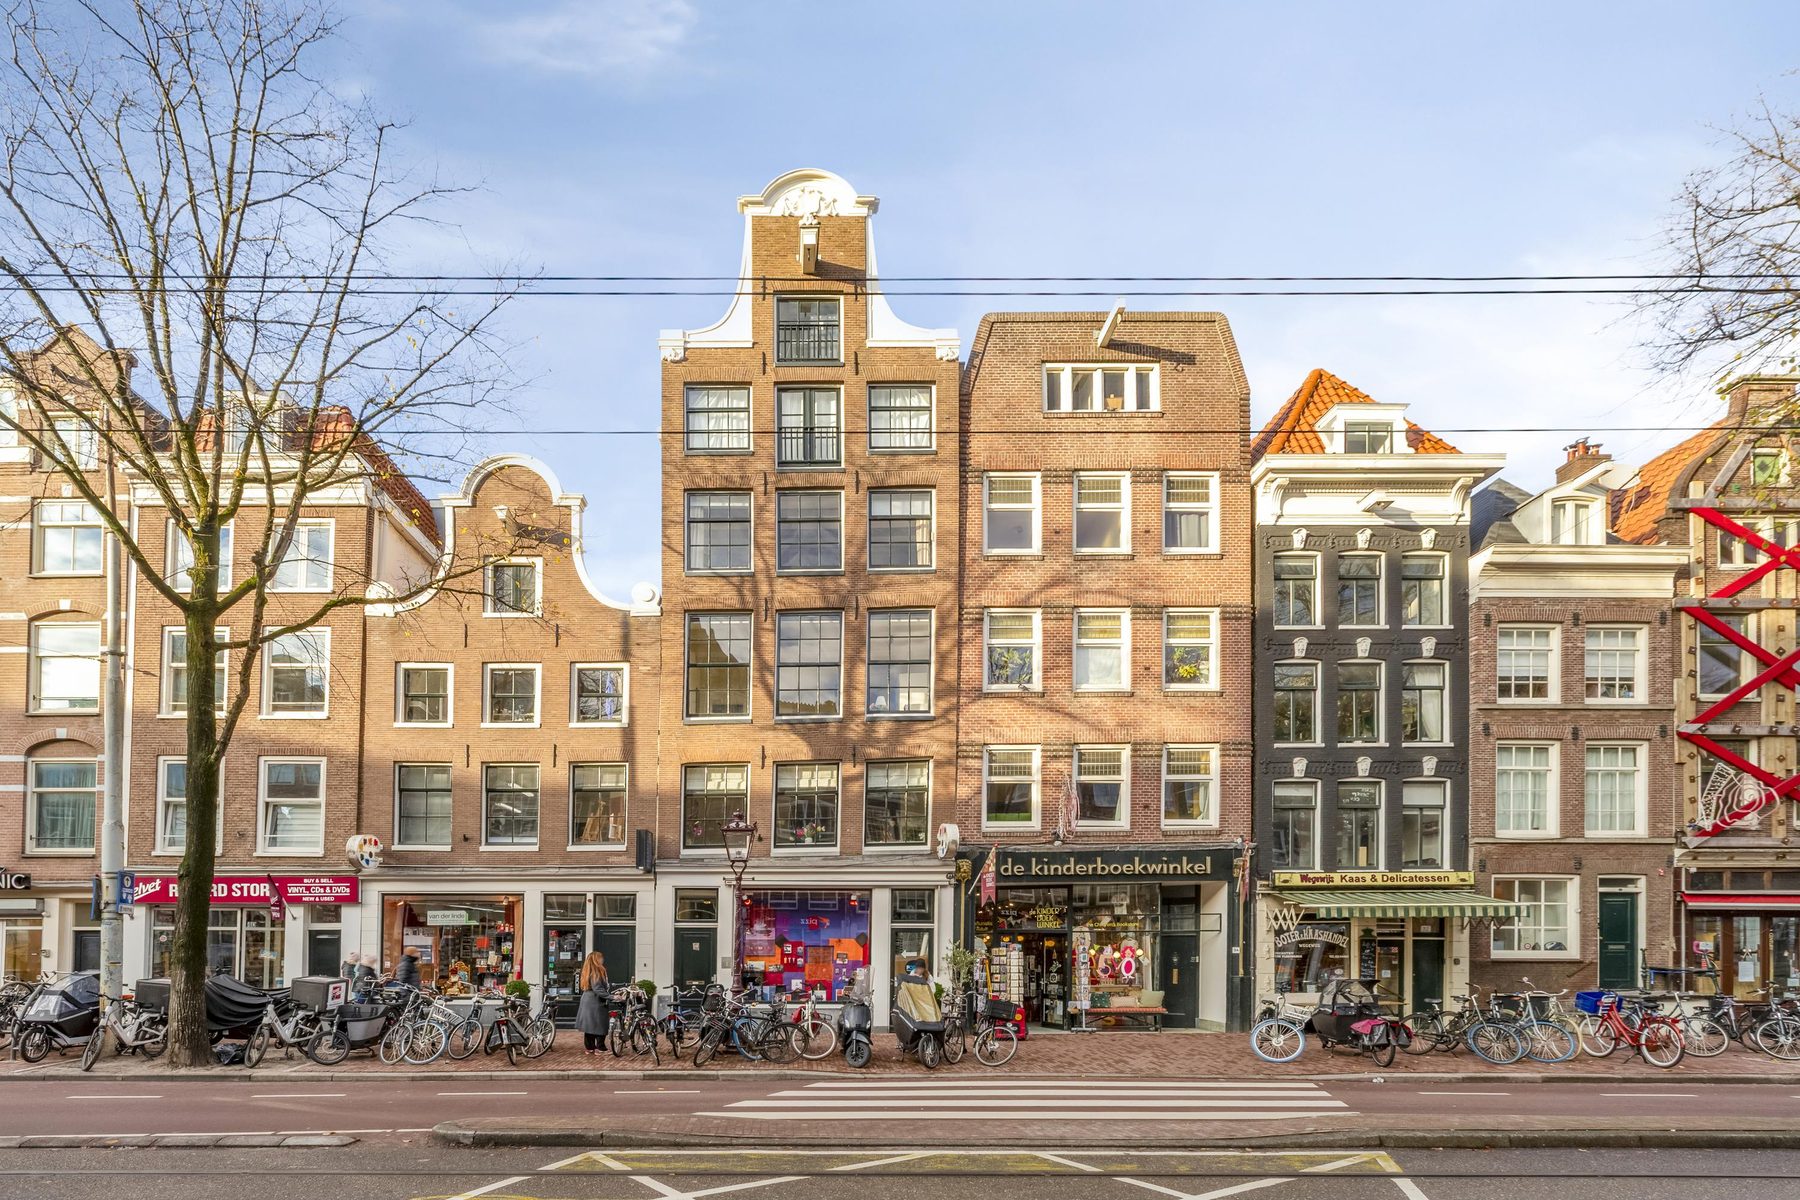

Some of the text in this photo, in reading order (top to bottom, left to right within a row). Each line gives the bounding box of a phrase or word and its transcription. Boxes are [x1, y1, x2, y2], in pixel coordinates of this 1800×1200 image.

[1000, 856, 1212, 876] de kinderboekwinkel
[1340, 874, 1367, 883] Kaas
[1370, 874, 1378, 883] &
[1382, 874, 1450, 883] Delicatessen
[134, 878, 161, 896] elvet
[169, 883, 279, 897] RRD STOR
[287, 886, 309, 894] VINYL,
[1274, 930, 1299, 948] BOTER
[1302, 926, 1350, 948] KAASHANDEL
